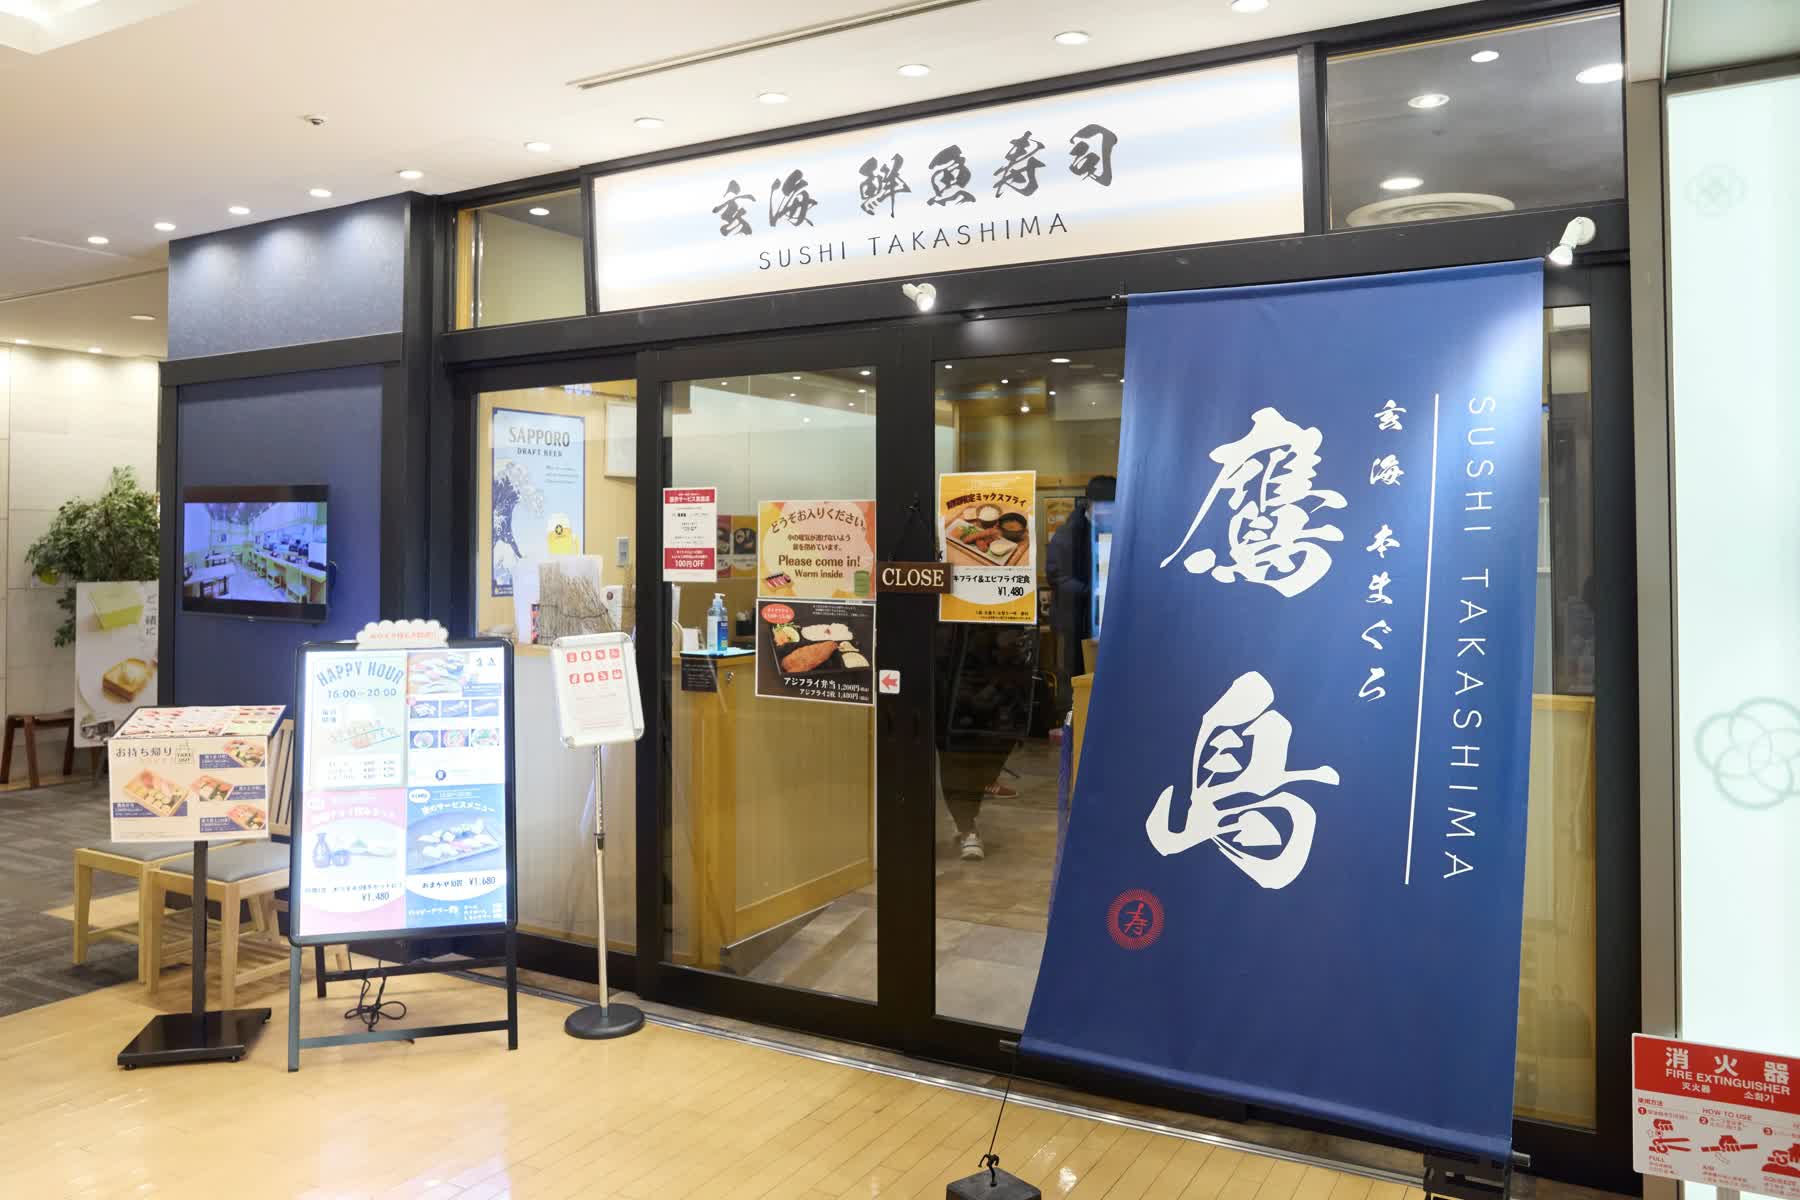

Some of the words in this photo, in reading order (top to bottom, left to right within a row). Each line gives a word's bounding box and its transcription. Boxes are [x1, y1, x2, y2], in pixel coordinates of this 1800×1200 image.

[712, 169, 818, 237] 玄海
[858, 124, 1118, 218] 鮮魚寿司
[759, 241, 846, 270] SUSHI
[868, 213, 1068, 257] TAKASHIMA
[509, 426, 570, 448] SAPPORO
[1369, 400, 1407, 486] 玄海
[1463, 396, 1497, 532] SUSHI
[778, 555, 812, 567] Please
[815, 557, 844, 567] come
[846, 555, 861, 567] in!
[794, 569, 819, 578] Warm
[820, 570, 844, 579] inside
[881, 567, 945, 588] CLOSE
[998, 586, 1025, 598] ¥1,480
[1358, 525, 1400, 702] 本まぐろ
[1145, 407, 1348, 890] 鷹島
[316, 660, 363, 687] HAPPY
[368, 661, 404, 685] HOUR
[1443, 568, 1489, 880] TAKASHIMA
[115, 746, 172, 758] お持ち帰り
[1665, 1068, 1693, 1081] FIRE
[1696, 1072, 1791, 1096] EXTINGUISHER
[1744, 1090, 1775, 1105] 소화기
[1702, 1108, 1721, 1116] HOW
[1723, 1110, 1734, 1118] TO
[1736, 1113, 1753, 1121] USE
